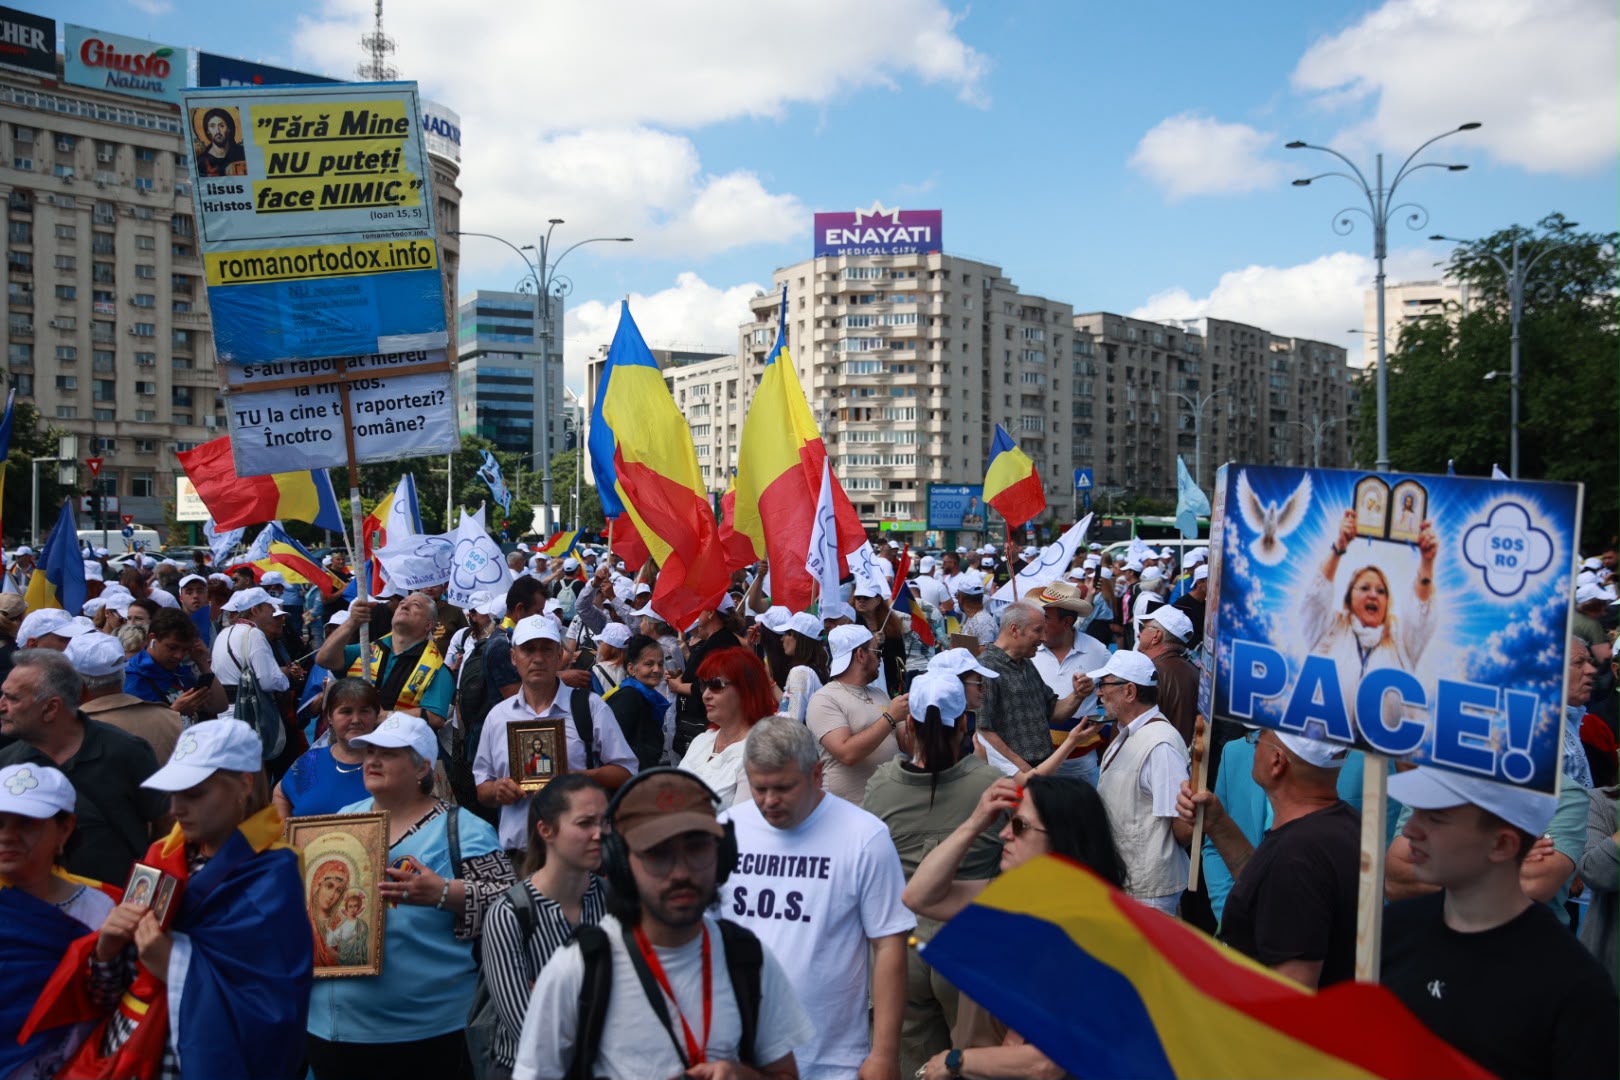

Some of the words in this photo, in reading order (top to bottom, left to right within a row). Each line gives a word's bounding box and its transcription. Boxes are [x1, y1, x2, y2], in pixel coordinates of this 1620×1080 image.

[81, 38, 171, 79] Giusto
[105, 71, 165, 93] Natura
[339, 110, 409, 136] Mine
[268, 151, 310, 174] NU
[207, 183, 244, 196] Iisus
[257, 187, 315, 209] face
[203, 201, 253, 213] Hristos
[397, 209, 411, 219] 15,
[412, 208, 423, 218] 5)
[362, 231, 428, 240] romanortodox.info
[826, 226, 931, 245] ENAYATI
[219, 241, 431, 279] romanortodox.info
[838, 247, 887, 255] MEDICAL
[892, 246, 917, 254] CITY
[244, 362, 284, 378] s-au
[371, 350, 427, 366] mereu
[236, 409, 261, 426] TU
[267, 407, 284, 423] la
[290, 404, 327, 420] cine
[356, 390, 445, 415] raportezi?
[264, 427, 332, 447] Încotro
[1491, 536, 1524, 552] SOS
[469, 551, 485, 565] SOS
[1495, 553, 1517, 568] RO
[1228, 638, 1540, 785] PACE!
[733, 885, 811, 923] S.O.S.
